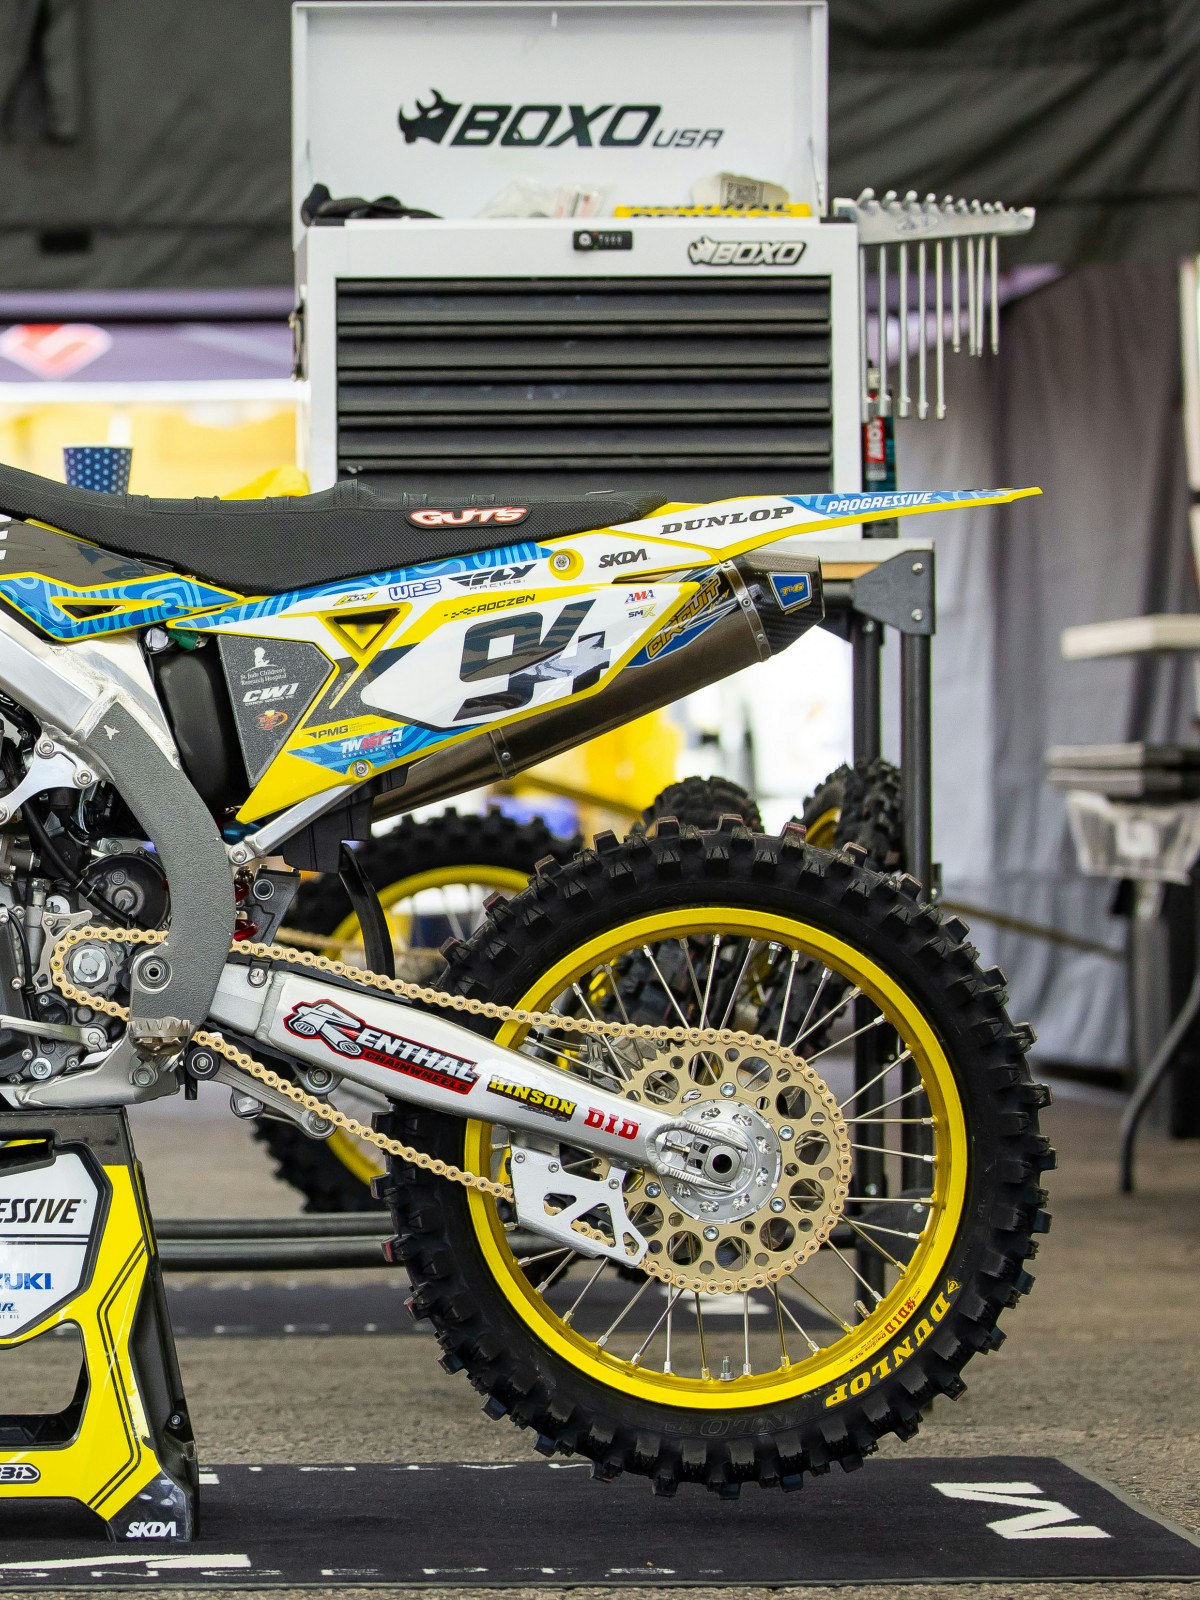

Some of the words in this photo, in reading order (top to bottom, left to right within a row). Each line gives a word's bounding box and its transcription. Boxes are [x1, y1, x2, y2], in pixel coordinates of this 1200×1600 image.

[449, 105, 662, 147] BOXO
[653, 129, 725, 149] USA
[710, 240, 806, 265] BOXO
[409, 506, 529, 525] GUTS
[826, 493, 933, 513] PROGRESSIVE
[659, 506, 794, 536] DUNLOP
[598, 548, 648, 568] SKDA
[460, 563, 537, 588] FLY
[388, 579, 442, 602] WPS
[477, 593, 536, 613] ROCZEN
[624, 589, 656, 604] AMA
[453, 598, 611, 721] 94
[316, 725, 349, 739] PMG
[341, 729, 403, 754] TWISTED
[363, 1050, 470, 1093] CHAINWHEELS
[487, 1075, 577, 1117] HINSON
[583, 1107, 640, 1140] D.I.D
[825, 1291, 951, 1408] DUNLOP
[125, 1521, 177, 1539] SKDA
